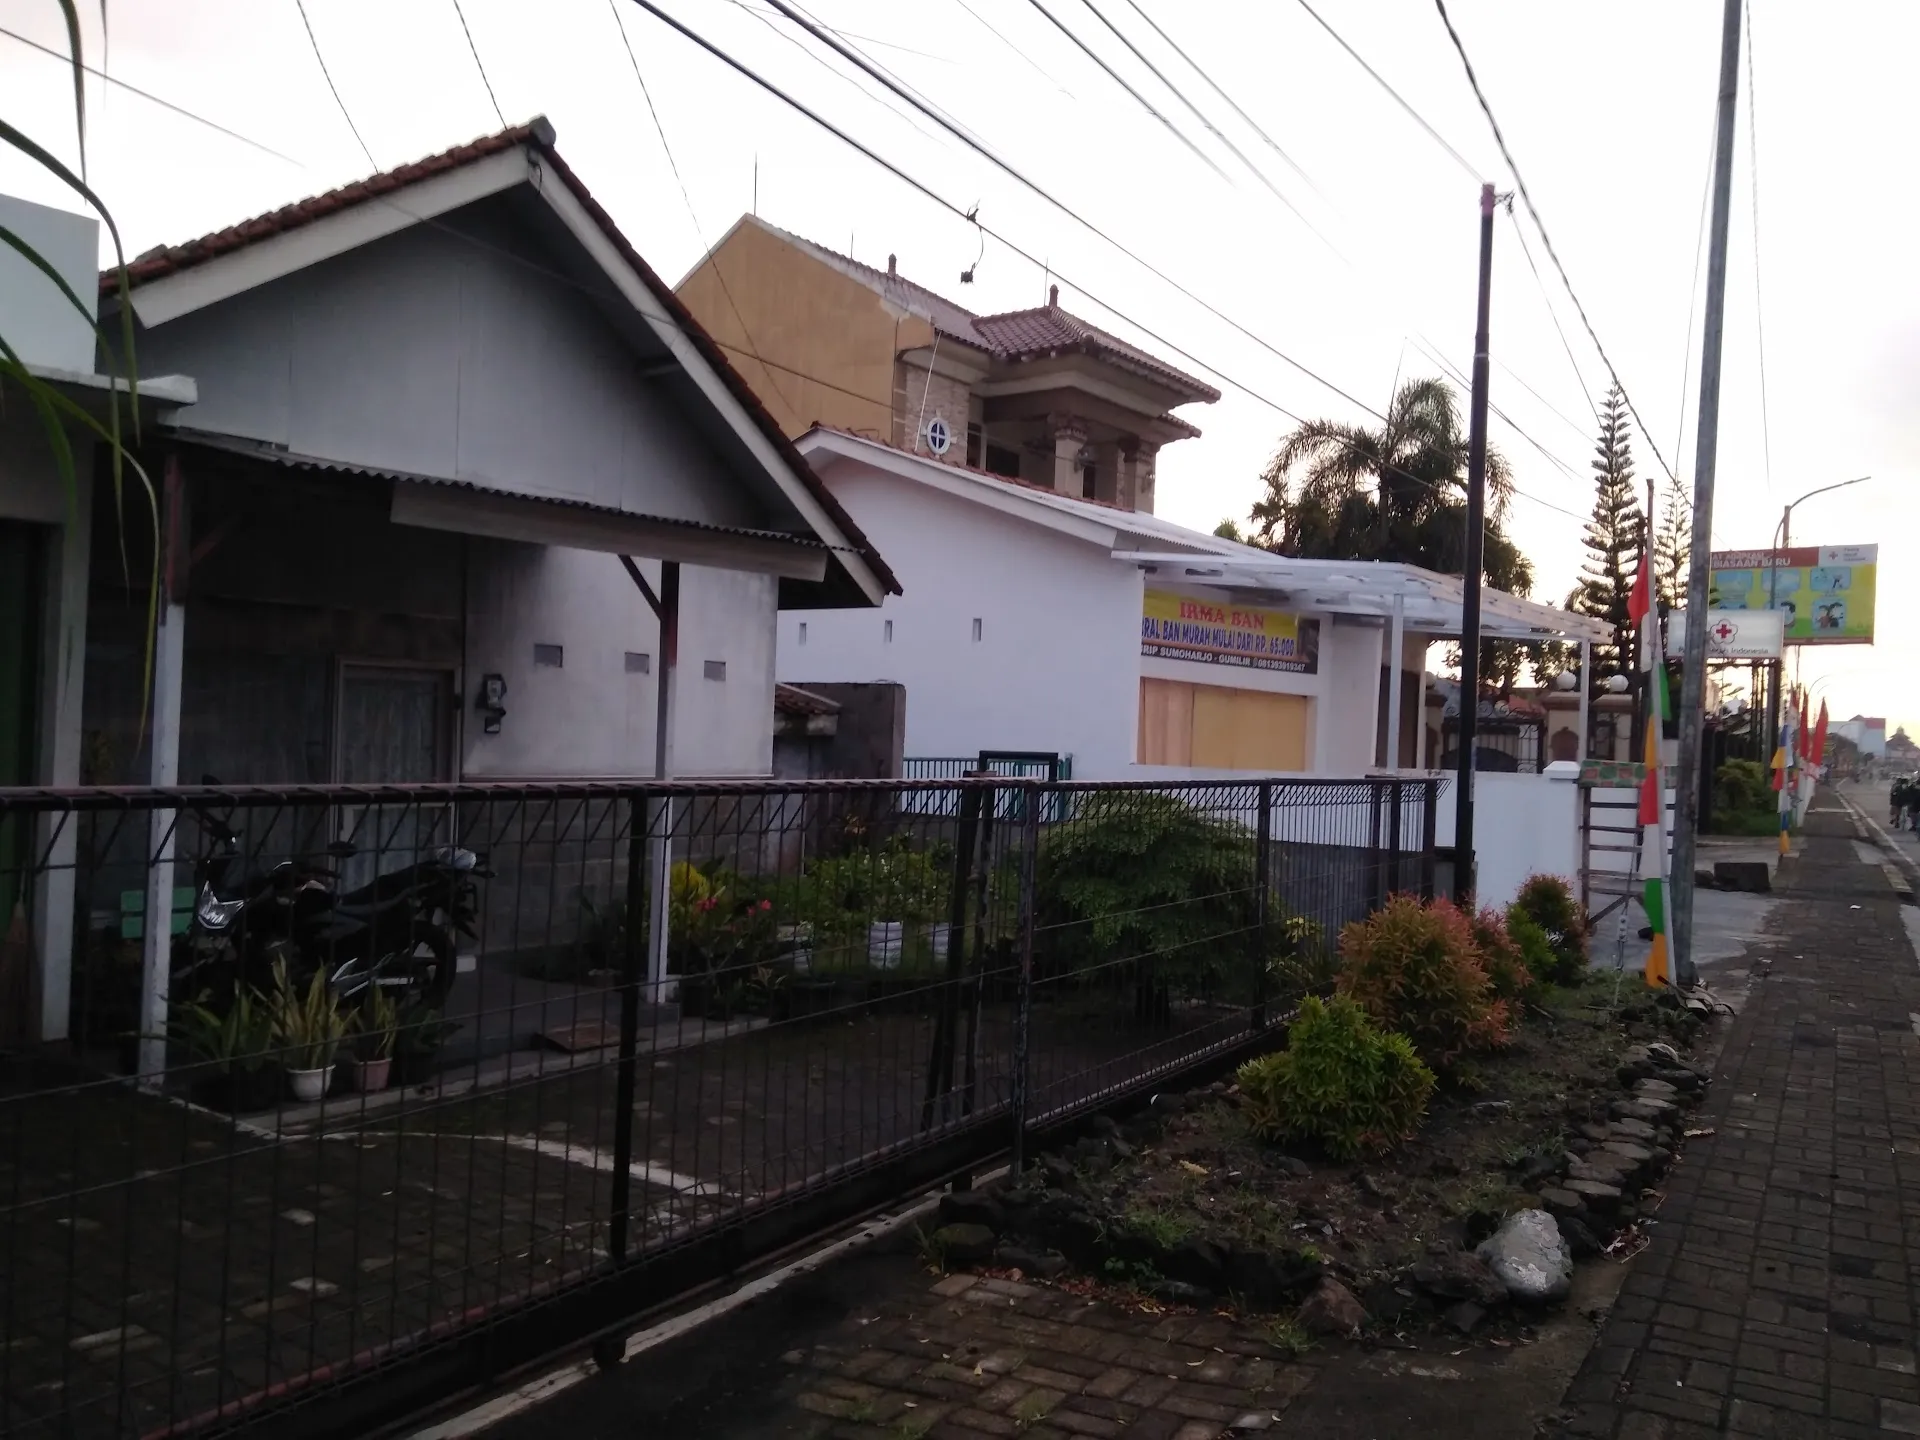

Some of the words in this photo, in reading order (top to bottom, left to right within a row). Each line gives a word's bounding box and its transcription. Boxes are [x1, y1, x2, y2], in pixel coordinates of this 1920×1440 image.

[1180, 602, 1225, 624] IRMA
[1231, 611, 1265, 629] BAN
[1163, 620, 1181, 642] BAN
[1182, 623, 1211, 646] MURAH
[1212, 627, 1236, 649] MULAI
[1237, 631, 1253, 651] DARI
[1255, 634, 1267, 653] RP.
[1142, 644, 1158, 655] RIP
[1160, 647, 1213, 662] SUMOHARJO
[1219, 654, 1251, 666] GUMILIR
